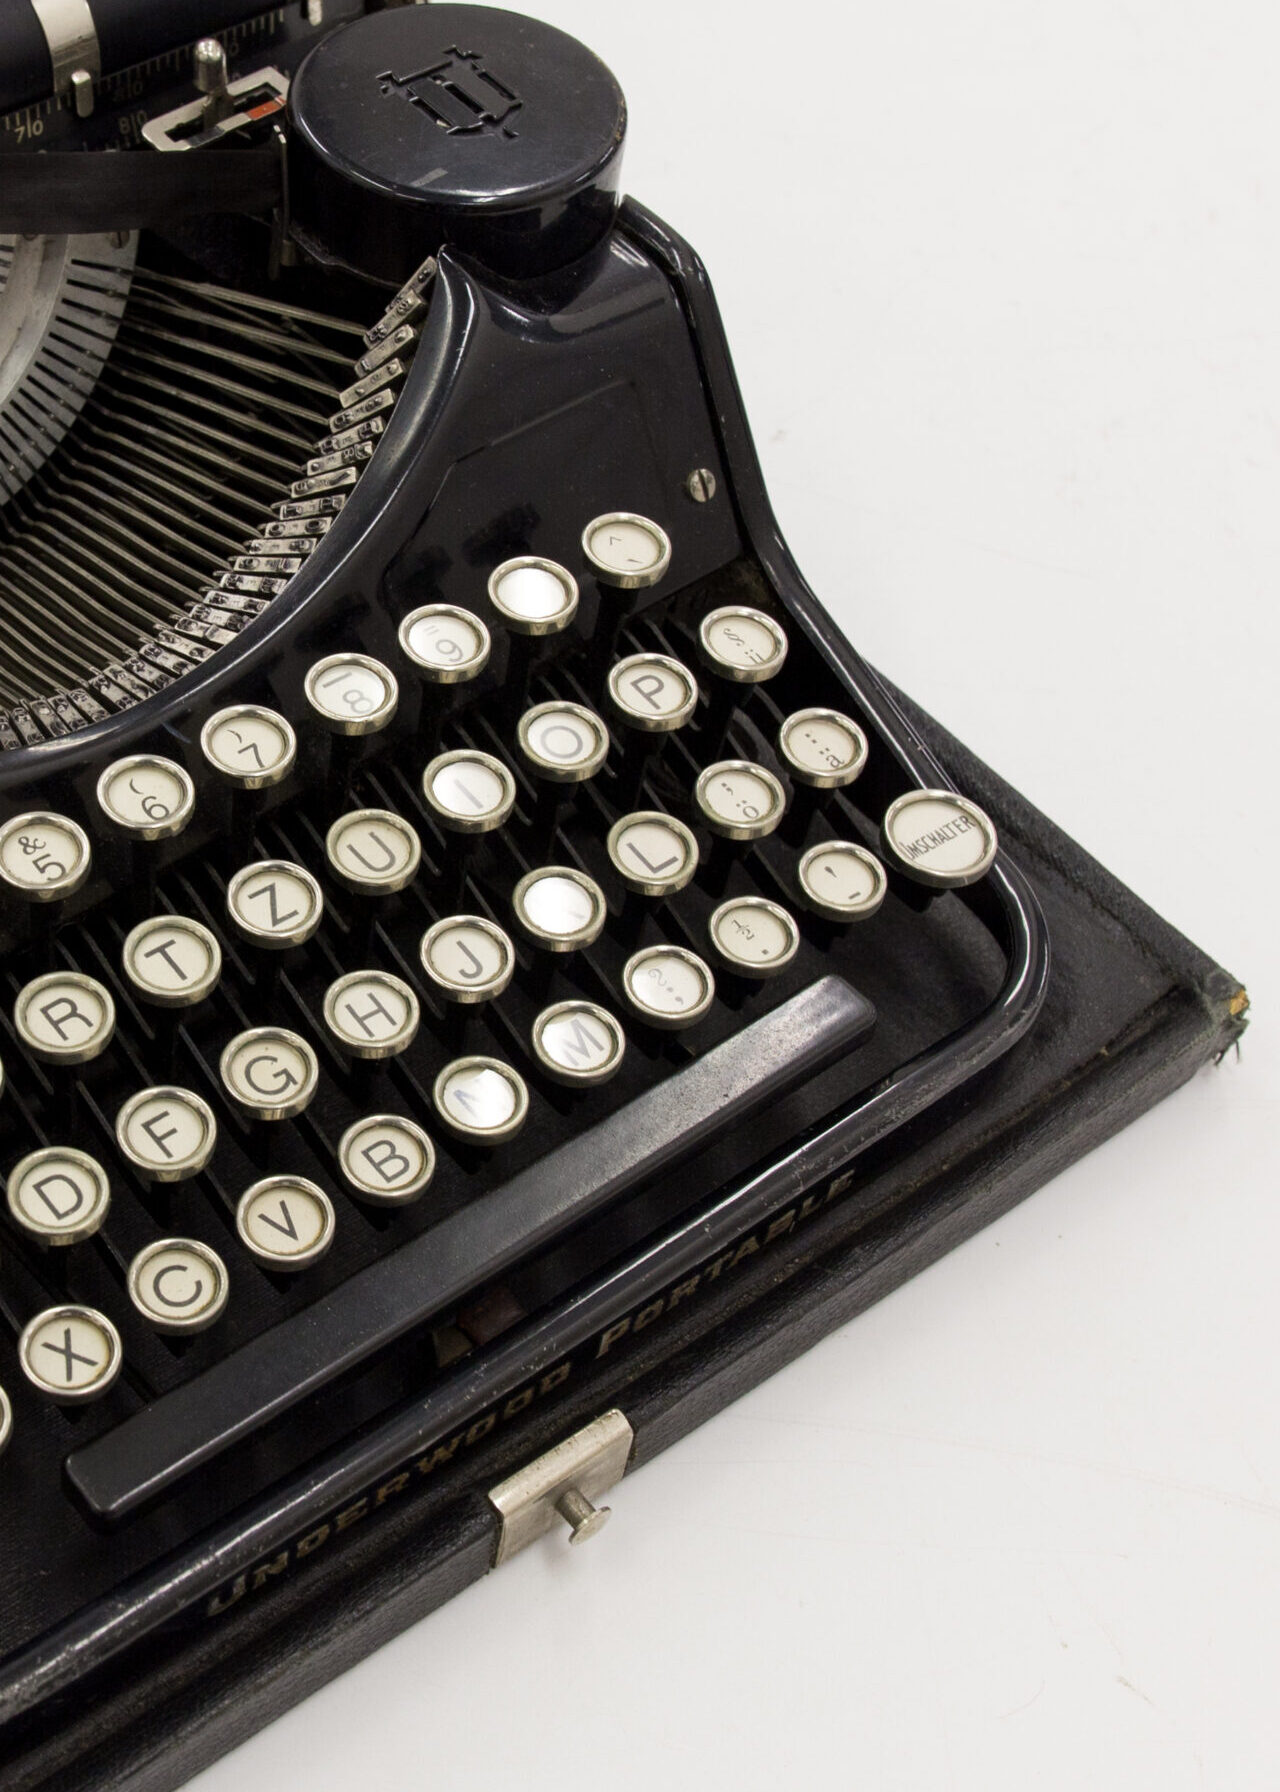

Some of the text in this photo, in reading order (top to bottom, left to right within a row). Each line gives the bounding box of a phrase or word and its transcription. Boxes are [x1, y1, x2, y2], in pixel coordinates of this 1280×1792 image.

[435, 638, 464, 663] 9
[342, 689, 373, 715] 8
[630, 674, 664, 710] P
[237, 742, 266, 769] 7
[540, 725, 584, 759] O
[141, 796, 170, 821] 6
[347, 831, 397, 873] U
[626, 842, 679, 874] L
[900, 815, 976, 860] UMSCHALTER
[32, 853, 66, 881] 5
[247, 882, 299, 928] Z
[144, 939, 188, 981] T
[455, 940, 484, 979] J
[39, 997, 94, 1041] R
[345, 992, 397, 1038] H
[244, 1055, 298, 1096] G
[140, 1110, 178, 1158] F
[361, 1139, 410, 1184] B
[32, 1174, 84, 1221] D
[258, 1200, 298, 1241] V
[153, 1264, 202, 1308] C
[41, 1327, 99, 1382] X
[206, 1168, 856, 1618] UNDERWOOD PORTABLE
